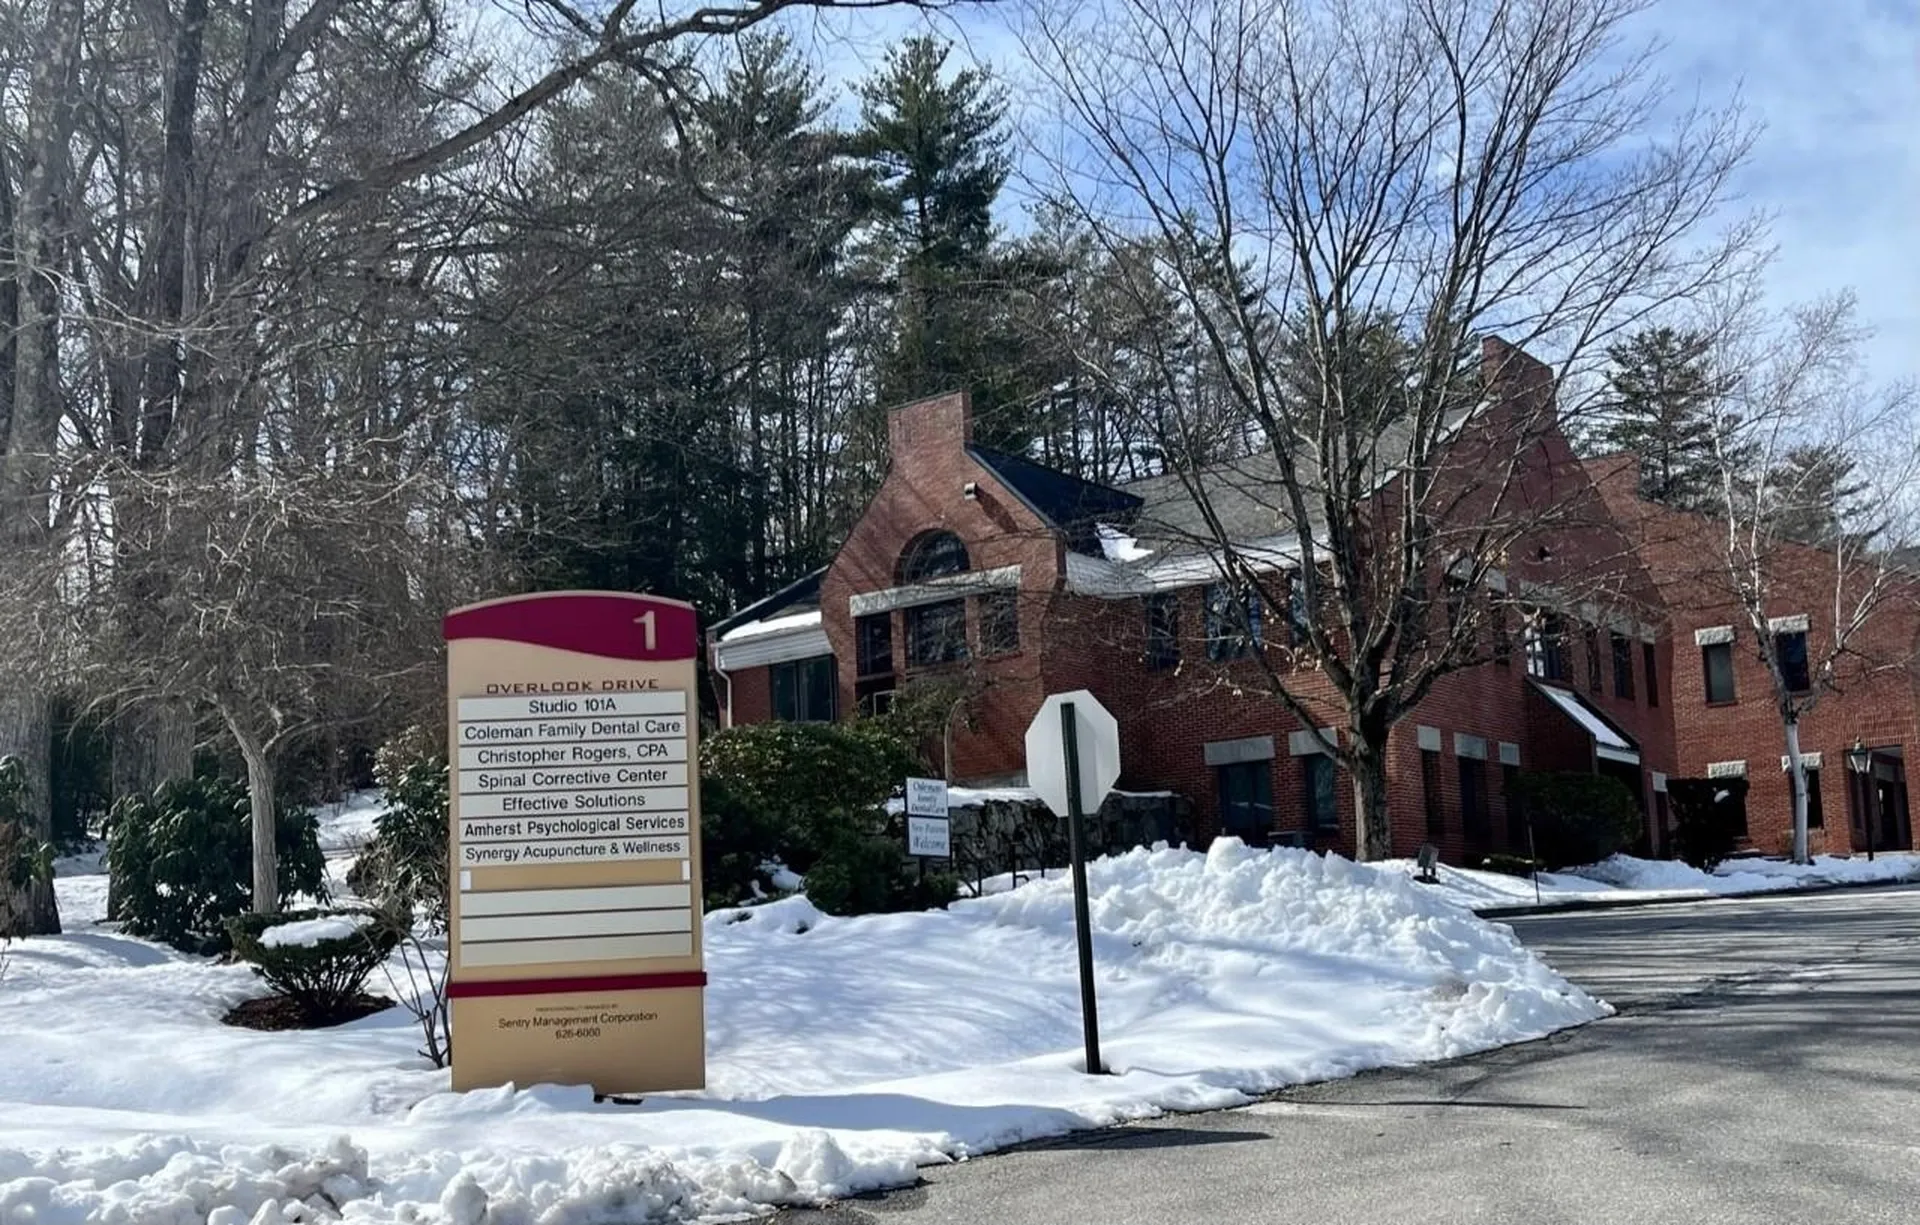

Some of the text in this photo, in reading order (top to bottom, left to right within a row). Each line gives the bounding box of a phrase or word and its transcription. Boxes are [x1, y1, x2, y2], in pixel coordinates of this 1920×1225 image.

[633, 610, 656, 651] 1
[486, 679, 659, 694] OVERLOOK DRIVE
[529, 698, 617, 714] Studio 101A
[465, 720, 680, 740] Coleman Family Dental Care
[478, 744, 668, 764] Christopher Rogers, CPA
[479, 769, 668, 790] Spinal Corrective Center
[503, 794, 646, 811] Effective Solutions
[465, 816, 685, 837] Amherst Psychological Services
[465, 841, 681, 862] Synergy Acupuncture & Wellness
[498, 1011, 658, 1029] Sentry Management Corporation
